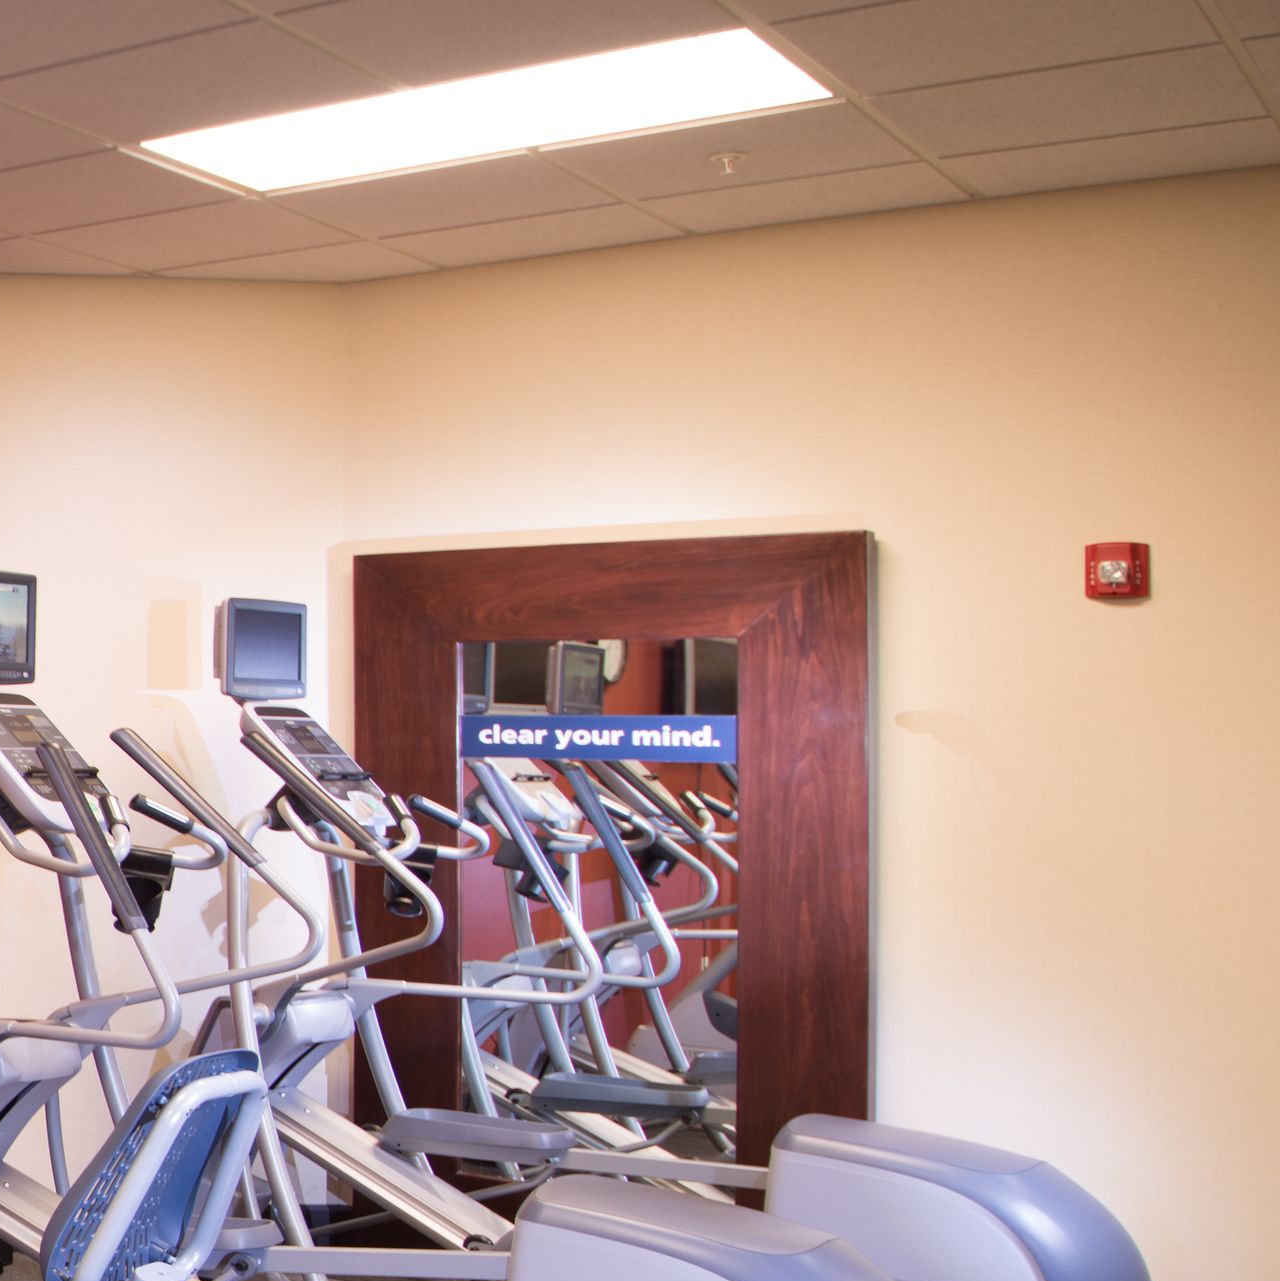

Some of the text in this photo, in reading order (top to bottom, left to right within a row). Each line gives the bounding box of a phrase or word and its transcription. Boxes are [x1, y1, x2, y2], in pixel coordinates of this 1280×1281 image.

[478, 723, 721, 750] clear your mind.
